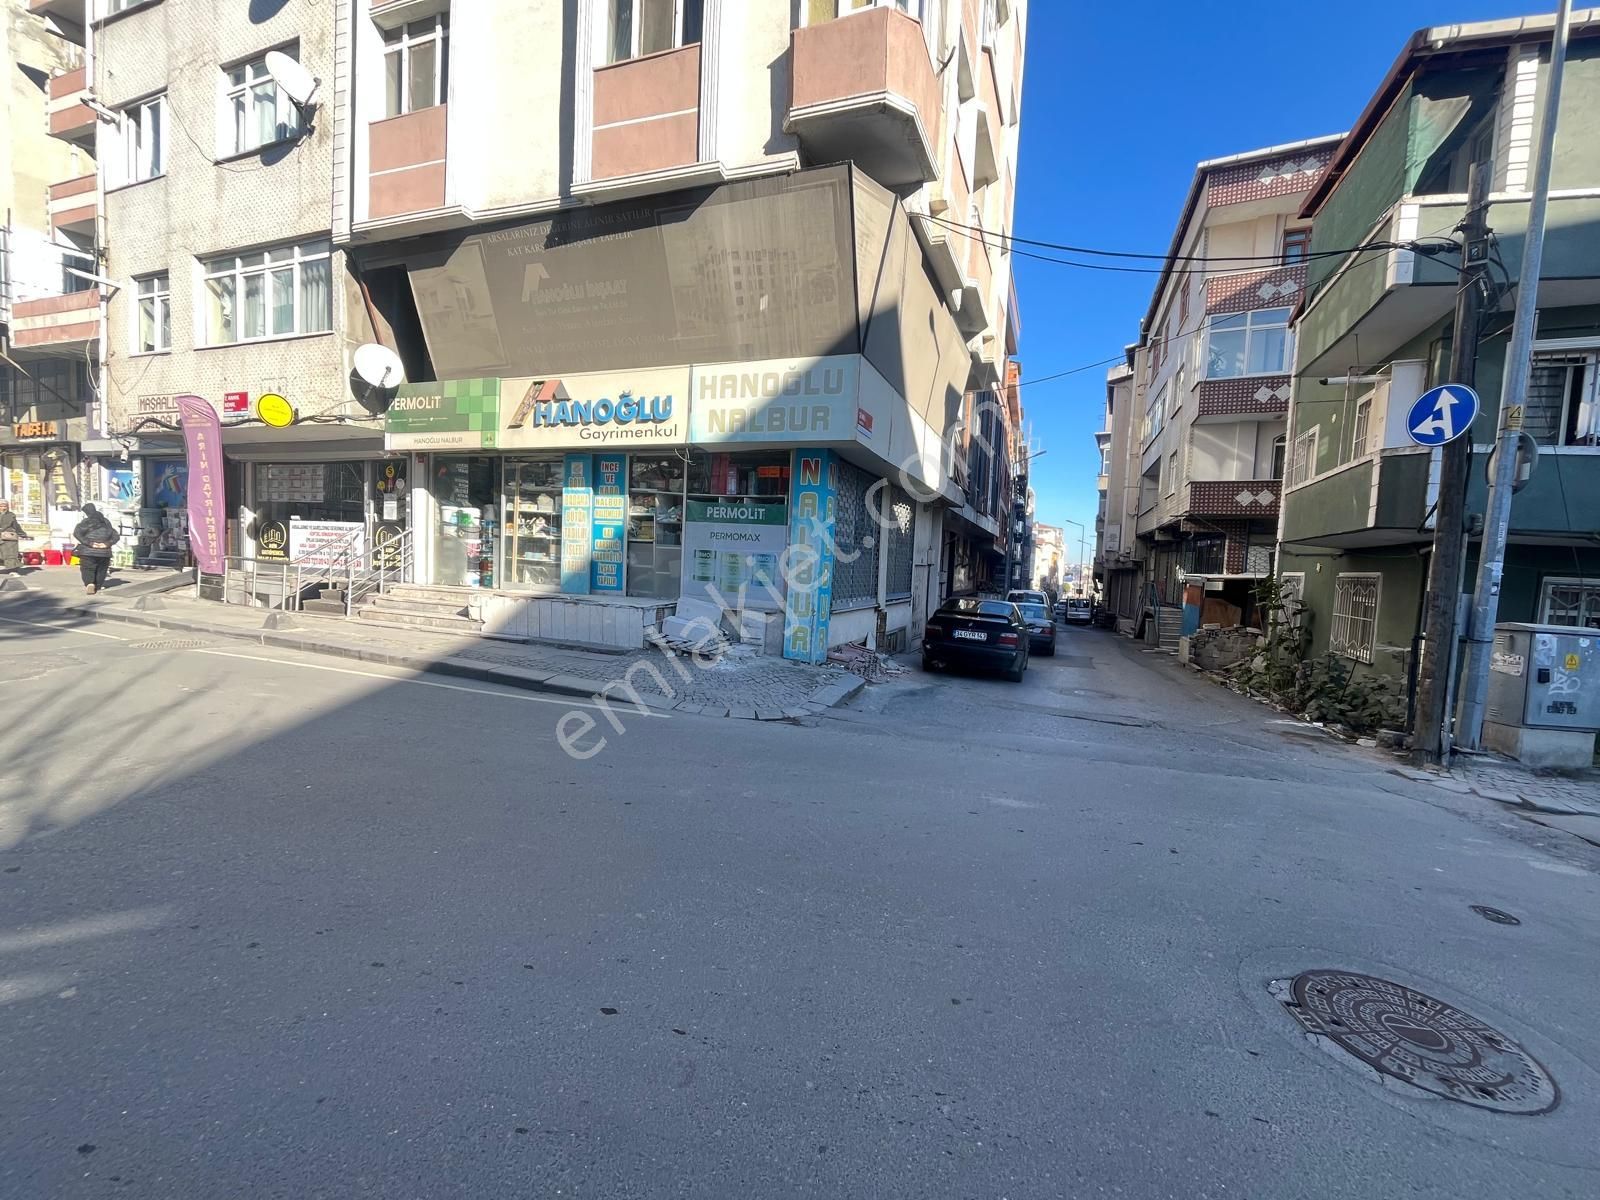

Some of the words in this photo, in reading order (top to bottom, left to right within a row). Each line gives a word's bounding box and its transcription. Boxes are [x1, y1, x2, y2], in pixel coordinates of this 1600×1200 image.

[700, 365, 844, 400] HANOĞLU
[535, 389, 673, 427] HANOĞLU
[708, 405, 831, 433] NALBUR
[15, 421, 57, 437] TABELA
[579, 424, 677, 442] Gayrimenkul
[605, 473, 615, 484] VE
[595, 498, 622, 507] NALBUR
[710, 532, 761, 542] PERMOMAX
[791, 457, 820, 653] NALBUR
